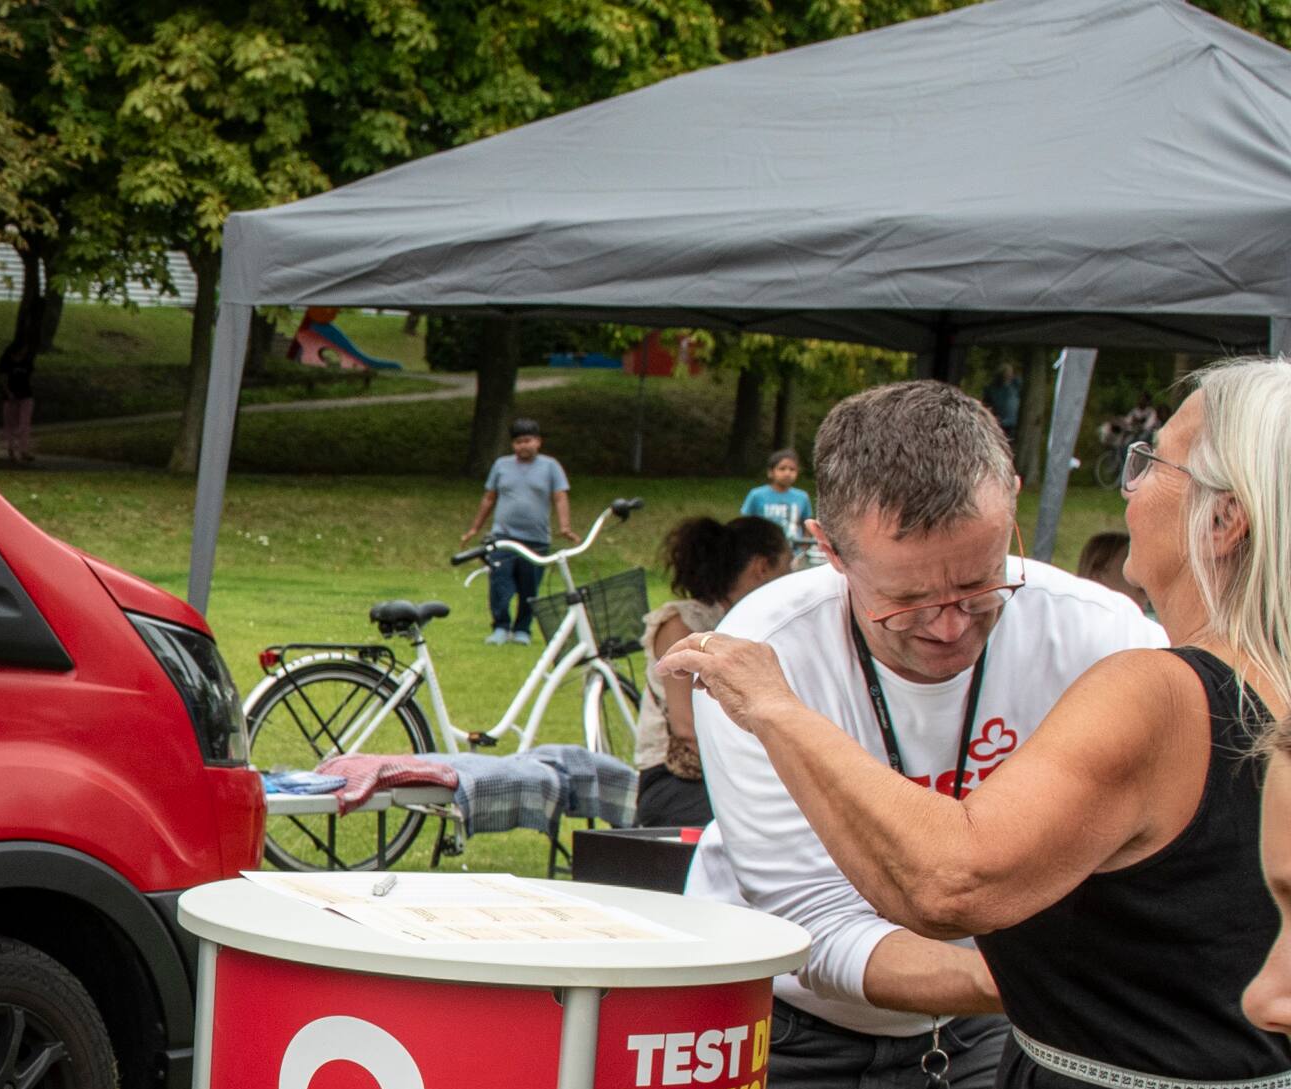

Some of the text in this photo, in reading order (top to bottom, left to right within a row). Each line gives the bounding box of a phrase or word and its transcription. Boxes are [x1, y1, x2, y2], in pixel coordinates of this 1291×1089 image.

[627, 1025, 748, 1087] TEST
[1061, 1058, 1069, 1067] 59
[1070, 1061, 1078, 1070] 58
[1079, 1064, 1087, 1074] 57
[1089, 1067, 1097, 1076] 56
[1099, 1070, 1108, 1079] 55
[1111, 1073, 1119, 1082] 54
[1122, 1076, 1131, 1085] 53
[1134, 1079, 1143, 1088] 52
[1147, 1081, 1156, 1089] 51
